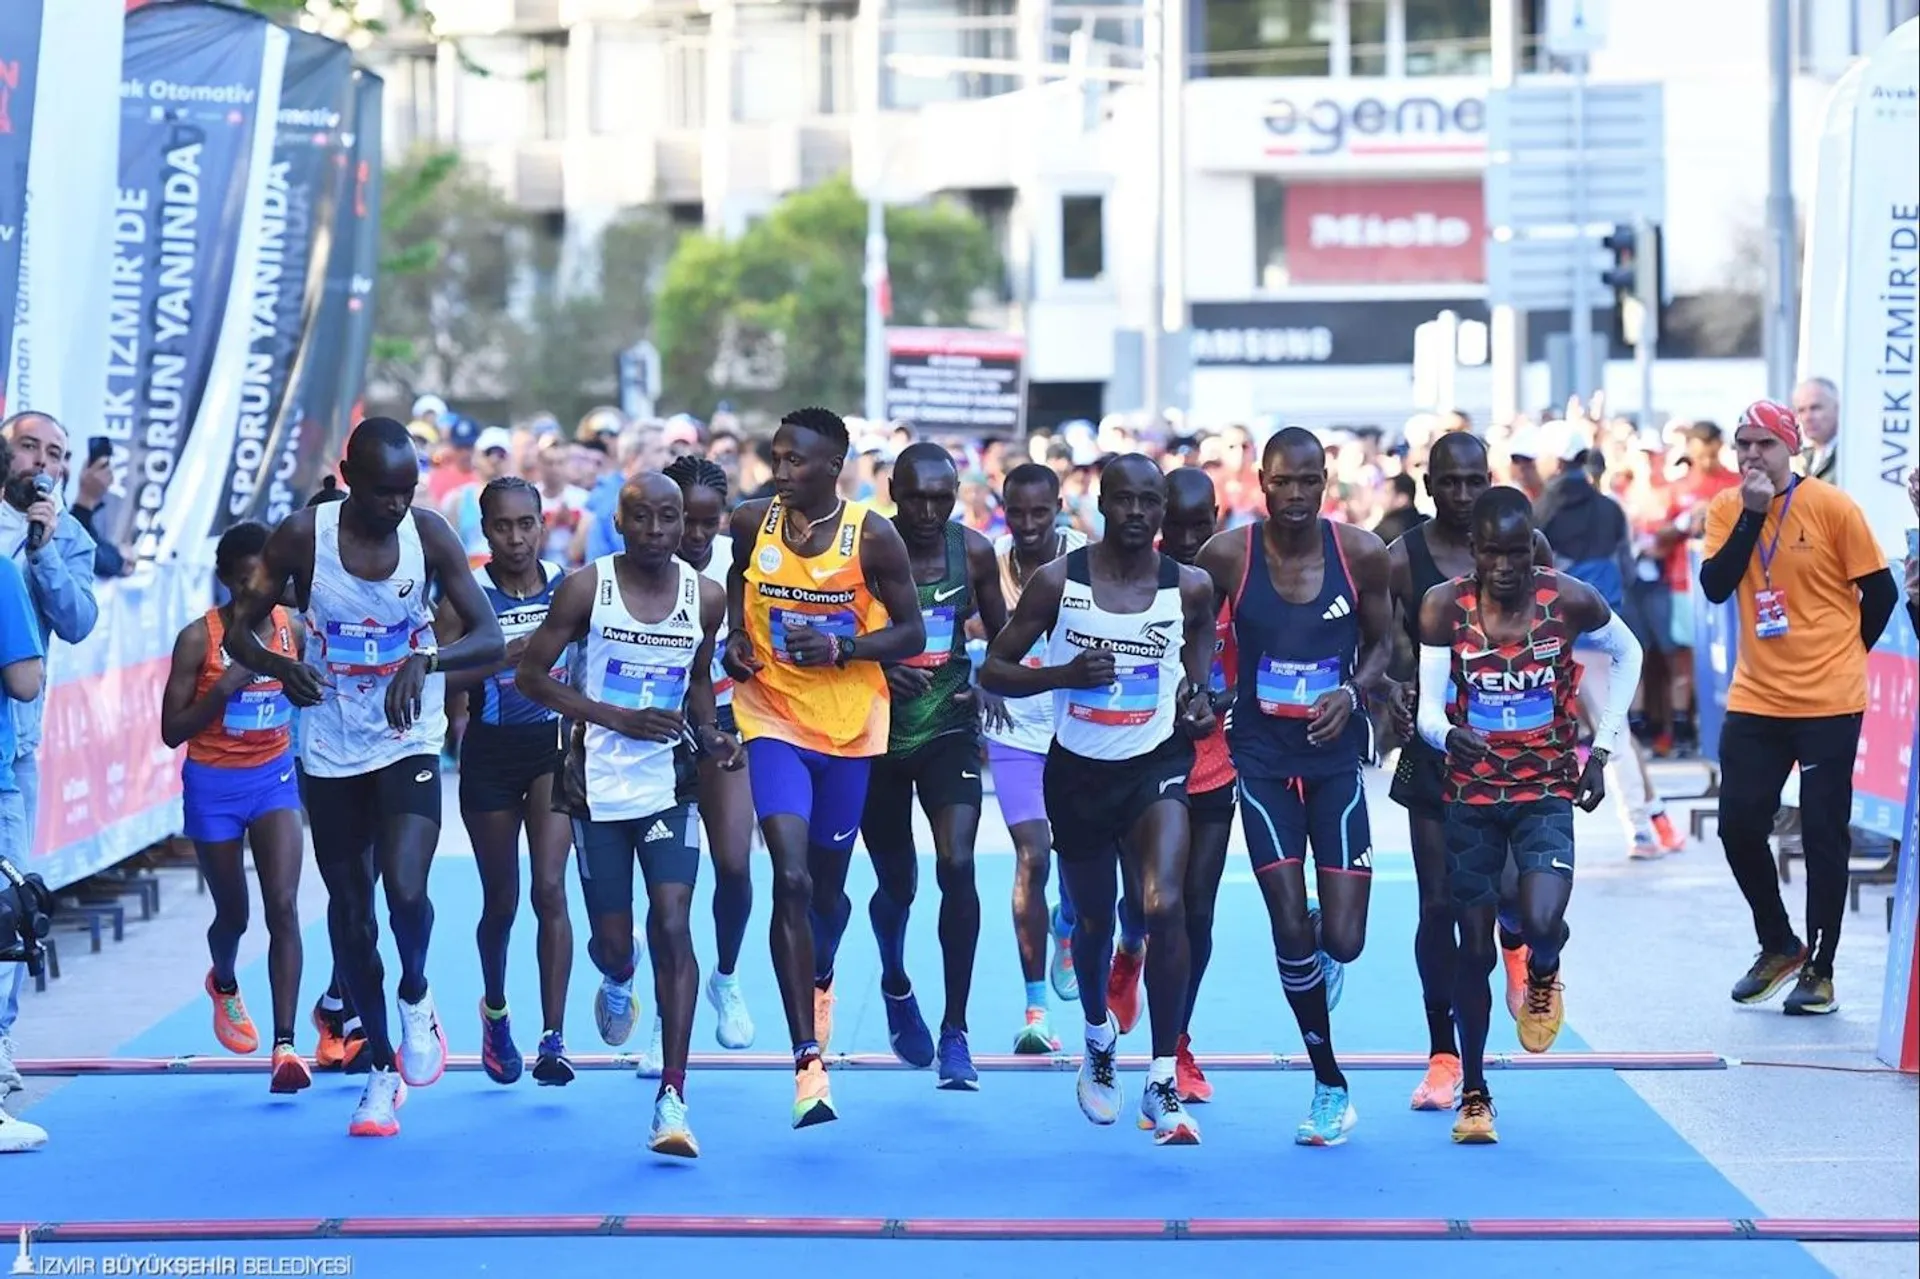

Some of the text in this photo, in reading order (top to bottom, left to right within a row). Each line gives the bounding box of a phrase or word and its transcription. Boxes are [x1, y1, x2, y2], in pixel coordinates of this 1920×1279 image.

[149, 79, 254, 104] Otomotiv
[154, 142, 203, 343] YANINDA
[229, 160, 291, 516] SPORUN YANINDA
[1189, 326, 1333, 361] AMSUNG
[1876, 203, 1919, 488] AVEK İZMİR'DE
[766, 503, 780, 533] Avek
[840, 526, 855, 556] Avek
[759, 584, 855, 603] Avek Otomotiv
[1064, 598, 1090, 609] Avek
[604, 628, 693, 648] Avek Otomotiv
[1067, 631, 1164, 657] Avek Otomotiv
[364, 639, 378, 664] 9
[1292, 677, 1308, 704] 4
[1462, 665, 1556, 691] KENYA
[638, 681, 656, 706] 5
[1107, 681, 1123, 709] 2
[256, 703, 275, 729] 12
[1502, 707, 1517, 730] 6
